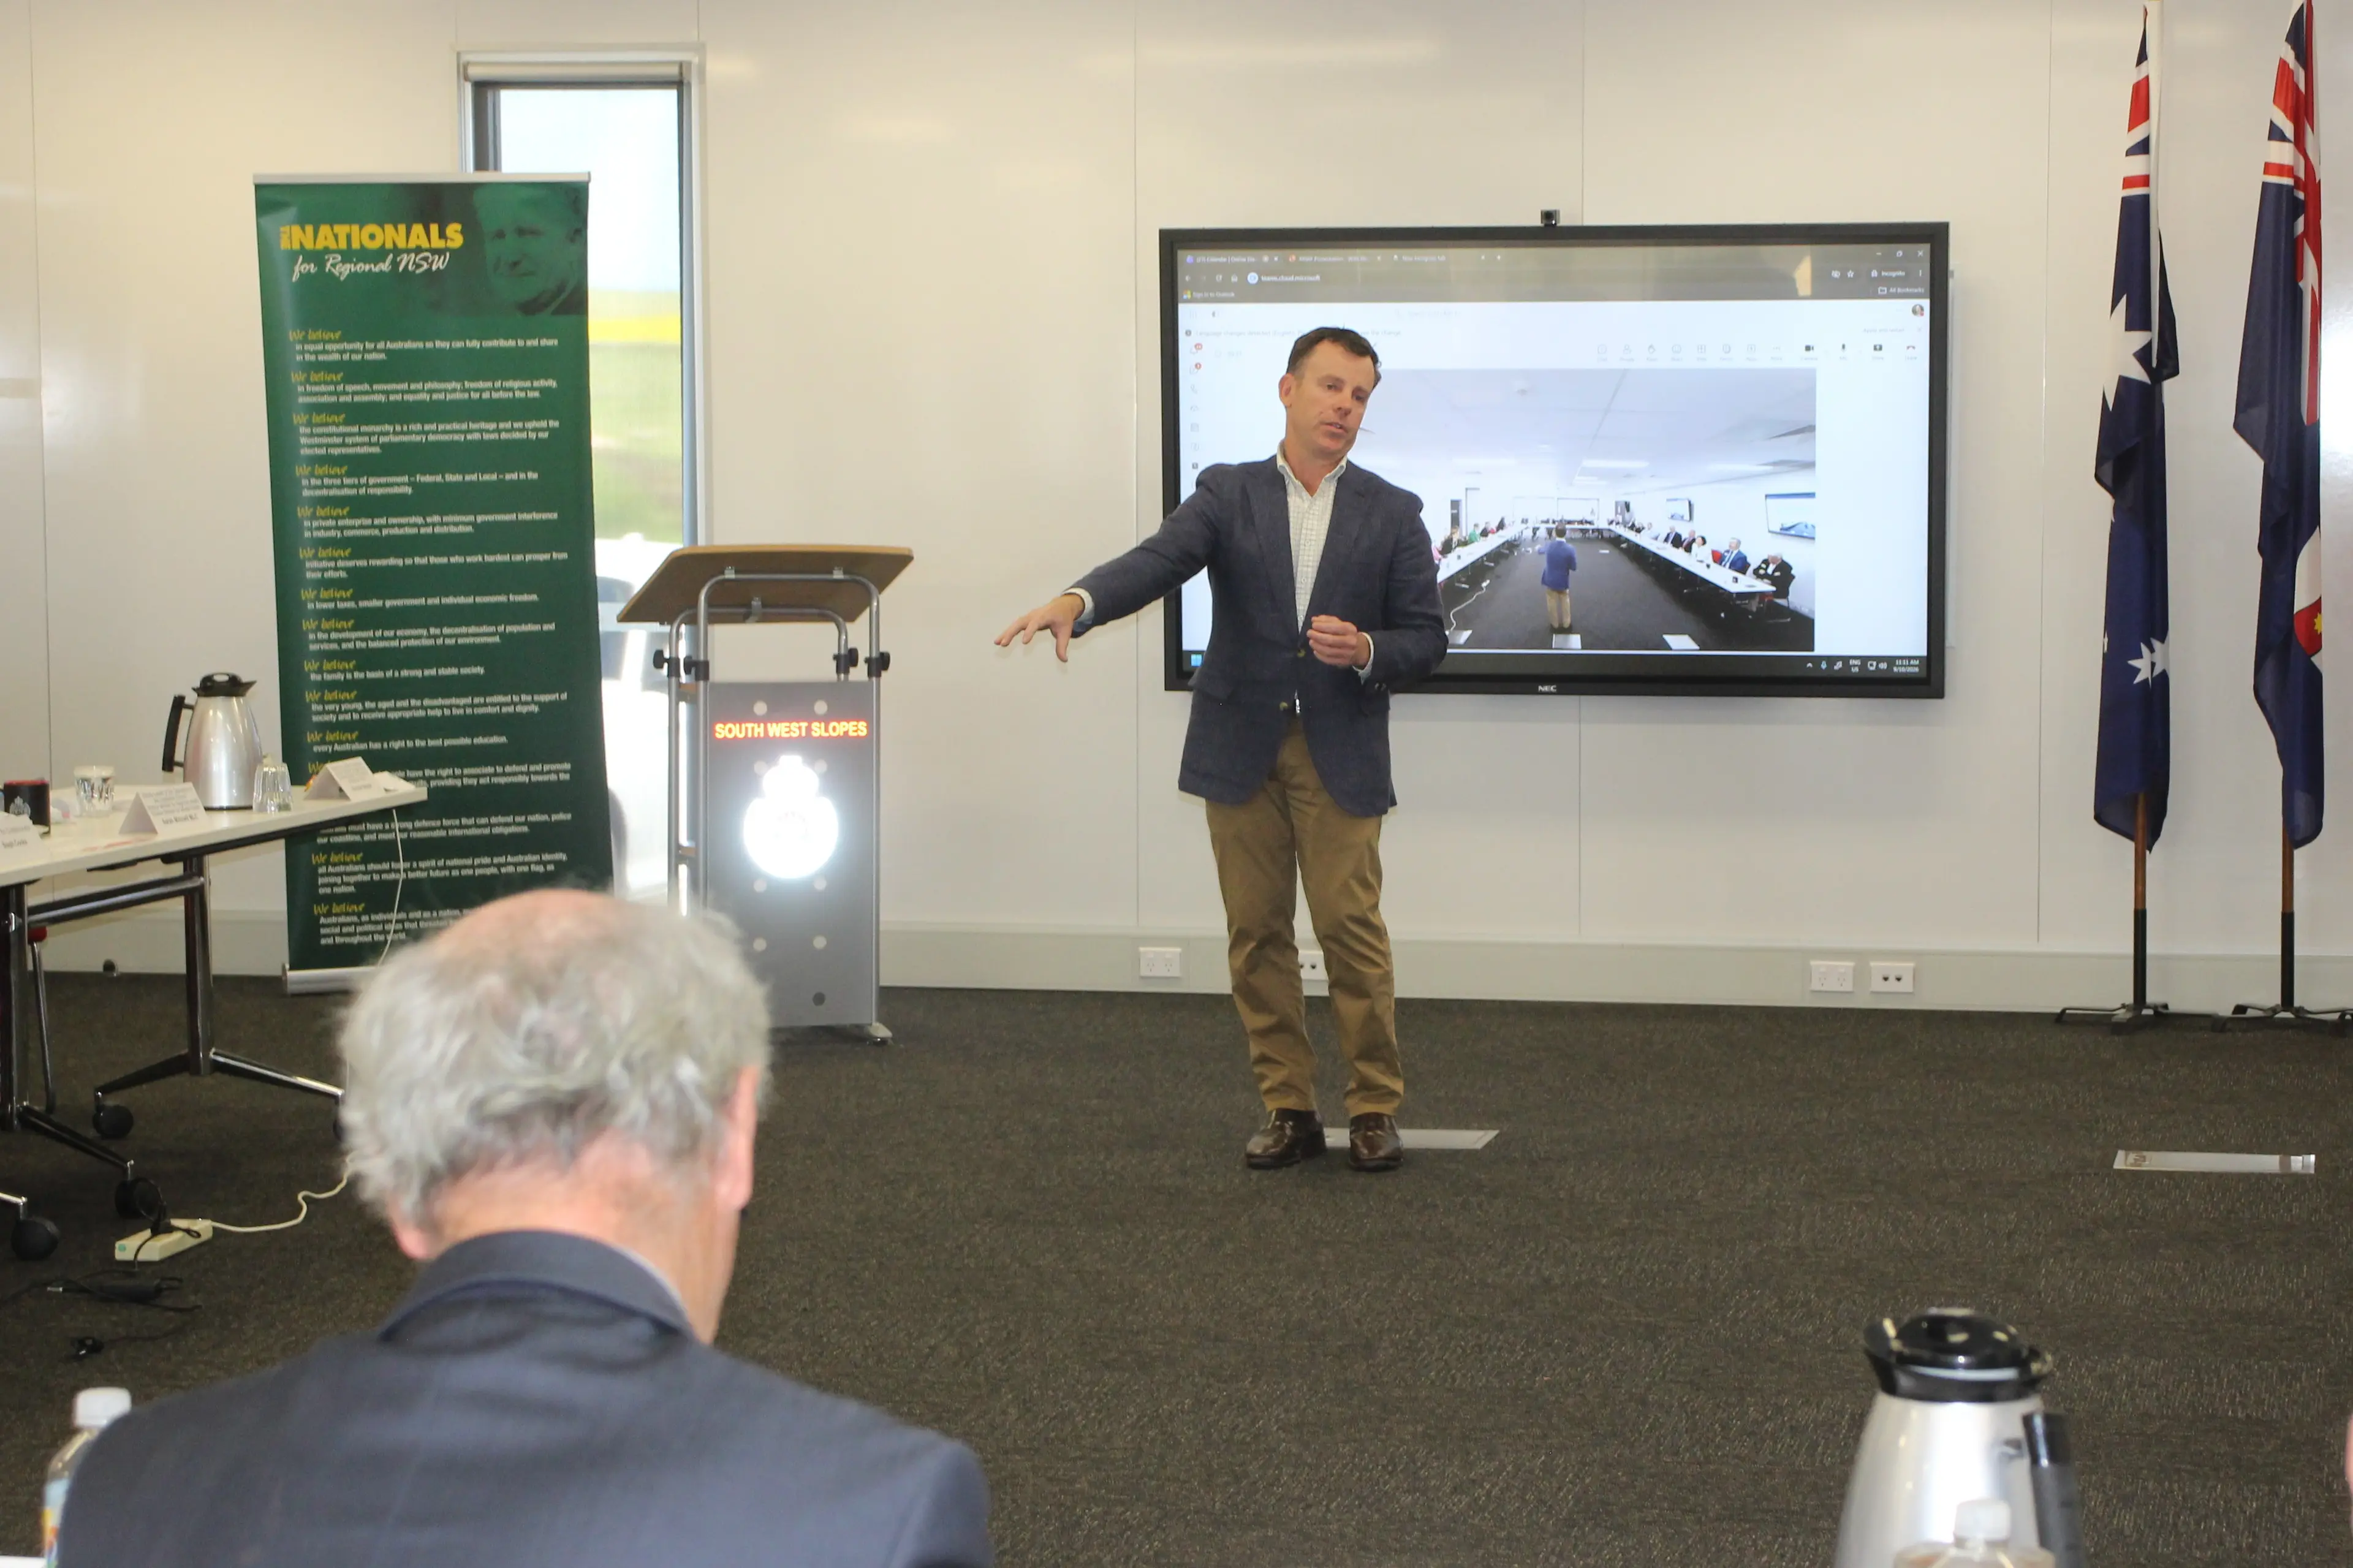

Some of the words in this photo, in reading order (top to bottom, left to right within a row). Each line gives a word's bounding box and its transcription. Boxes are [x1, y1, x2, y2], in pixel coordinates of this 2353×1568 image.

[290, 222, 464, 251] NATIONALS
[292, 254, 317, 282] for
[325, 253, 393, 281] Regional
[397, 251, 450, 275] NSW
[289, 329, 305, 341] We
[308, 329, 341, 341] believe
[290, 370, 307, 382] We
[310, 370, 343, 382] believe
[292, 412, 309, 424] We
[312, 412, 346, 424] believe
[295, 464, 311, 476] We
[314, 464, 348, 476] believe
[297, 505, 314, 517] We
[316, 505, 349, 517] believe
[299, 546, 316, 558] We
[318, 546, 351, 558] believe
[301, 587, 317, 599] We
[320, 587, 353, 599] believe
[303, 618, 318, 631] We
[321, 618, 354, 631] believe
[304, 659, 320, 671] We
[323, 659, 355, 671] believe
[305, 689, 321, 702] We
[324, 689, 357, 702] believe
[307, 730, 323, 742] We
[325, 730, 358, 742] believe
[714, 722, 764, 739] SOUTH
[767, 721, 808, 738] WEST
[810, 721, 868, 737] SLOPES
[311, 850, 327, 863] We
[330, 850, 363, 863] believe
[314, 903, 329, 915] We
[332, 903, 365, 915] believe
